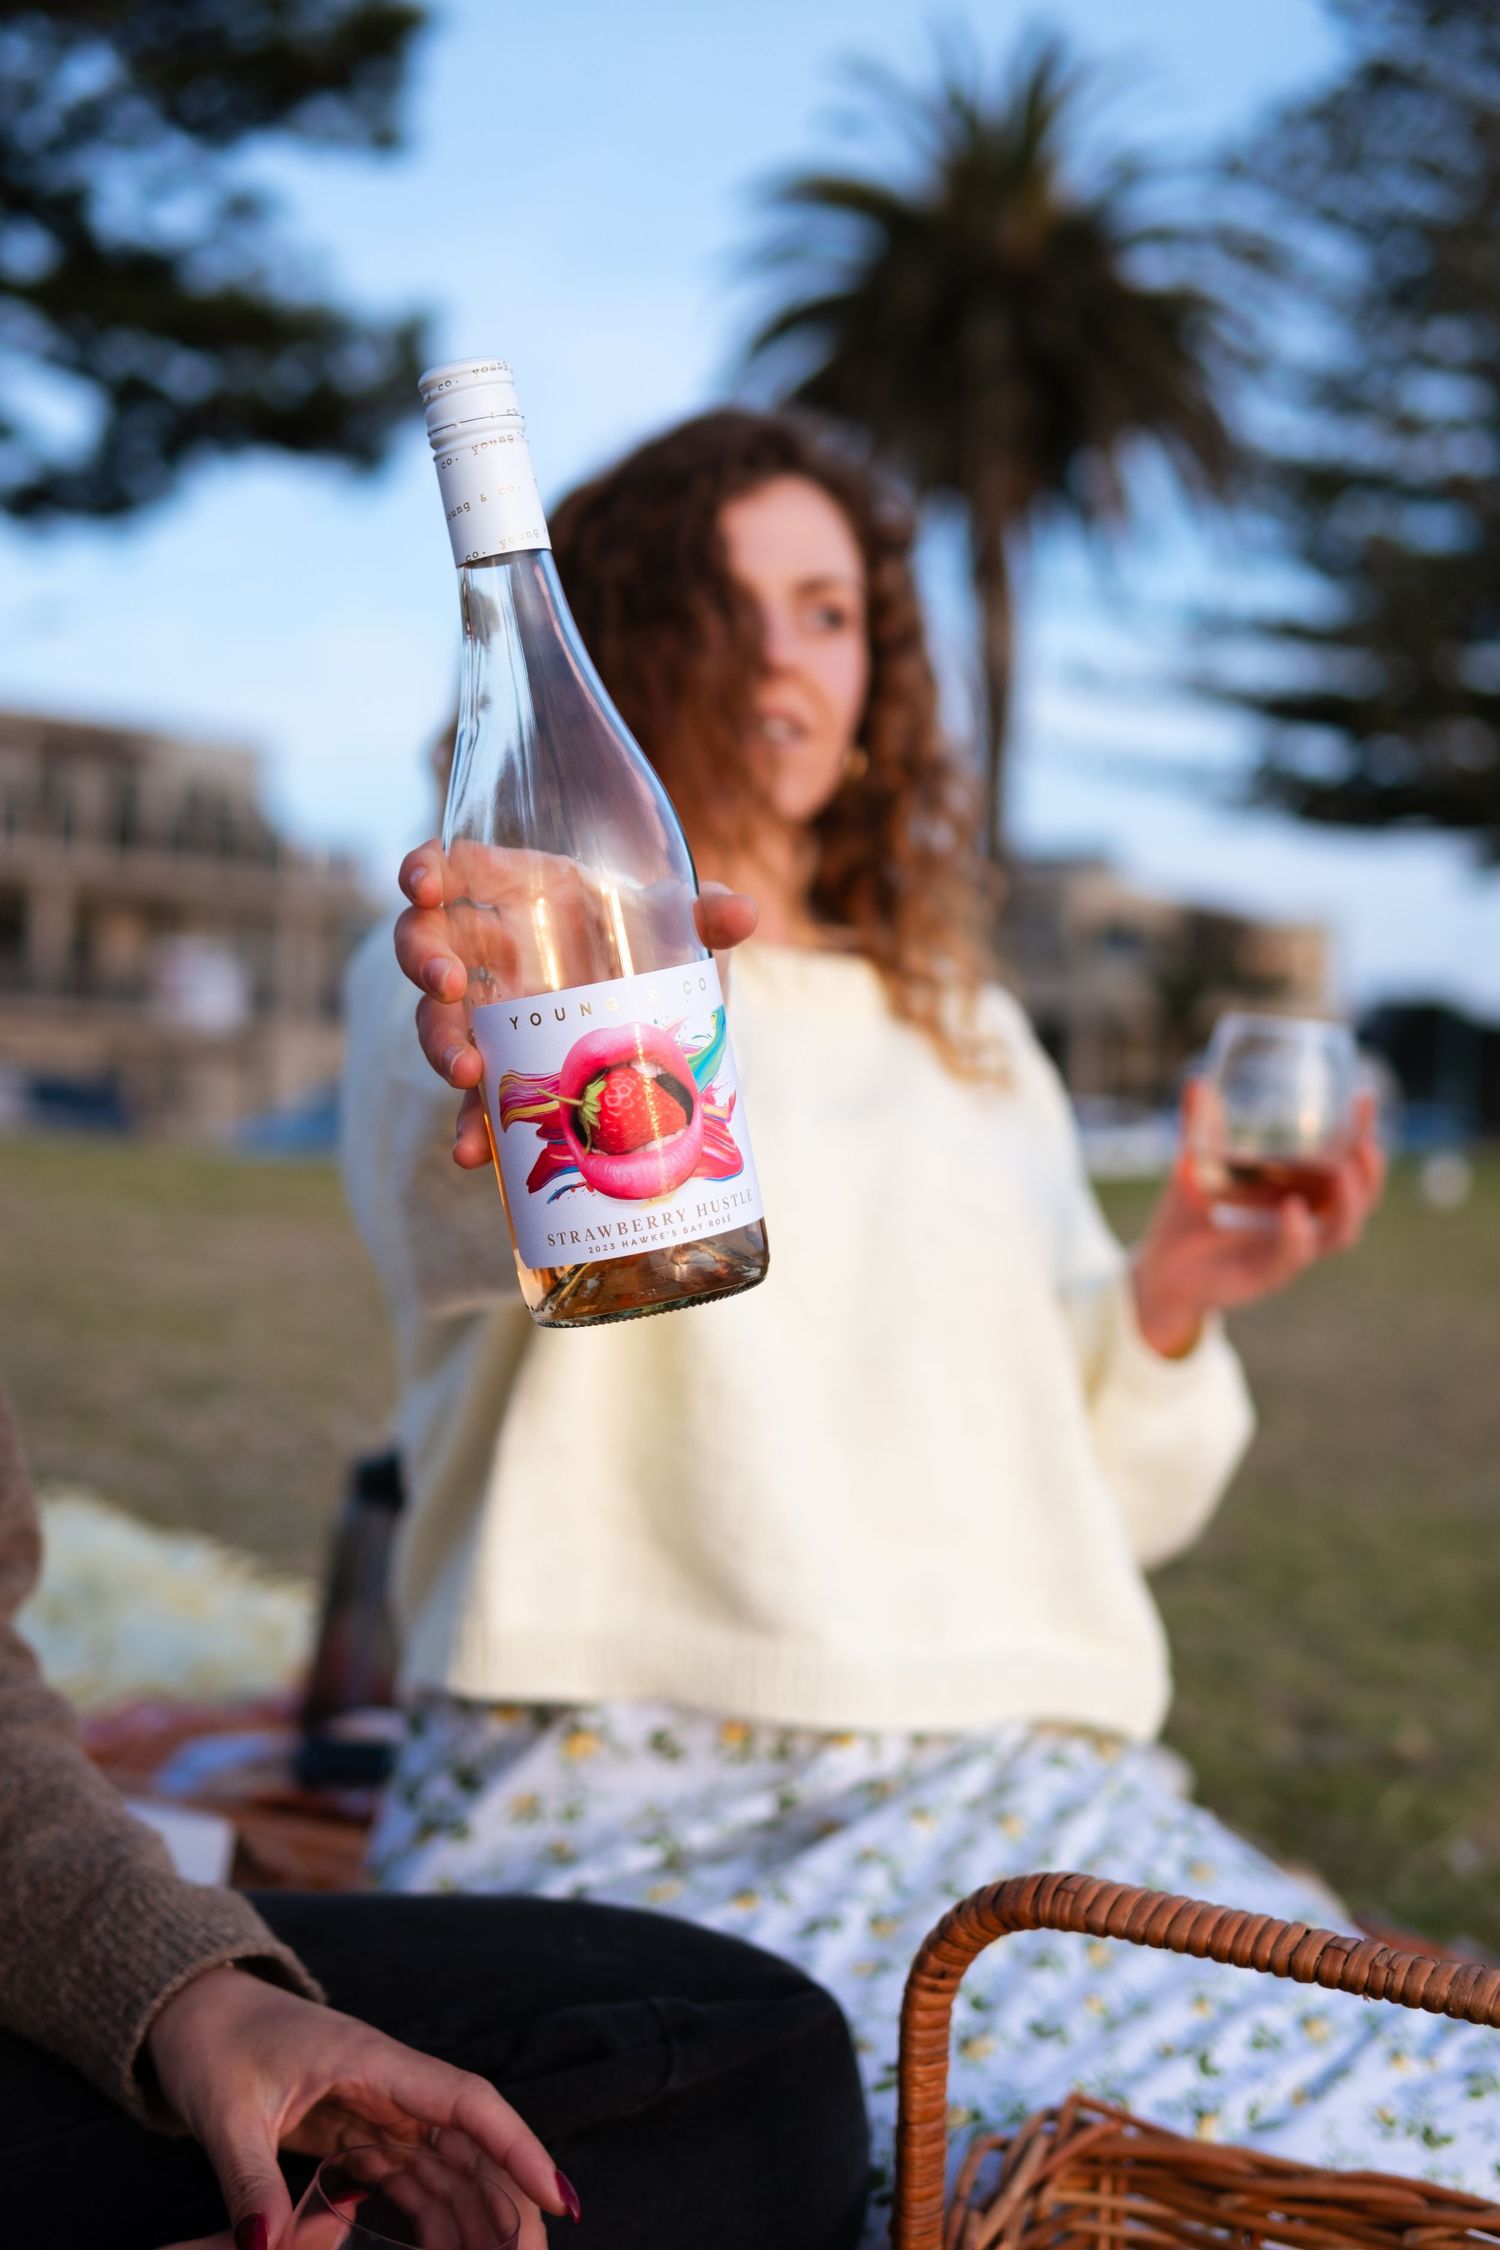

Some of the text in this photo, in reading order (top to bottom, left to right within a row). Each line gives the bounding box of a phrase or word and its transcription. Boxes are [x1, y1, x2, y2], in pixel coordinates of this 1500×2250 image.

[471, 434, 514, 456] young
[498, 528, 540, 550] young
[509, 996, 619, 1031] YOUNG
[682, 977, 706, 994] CO
[547, 1188, 753, 1247] STRAWBERRY HUSTLE
[588, 1213, 732, 1254] 2023 HAWKE'S BAY ROSÉ
